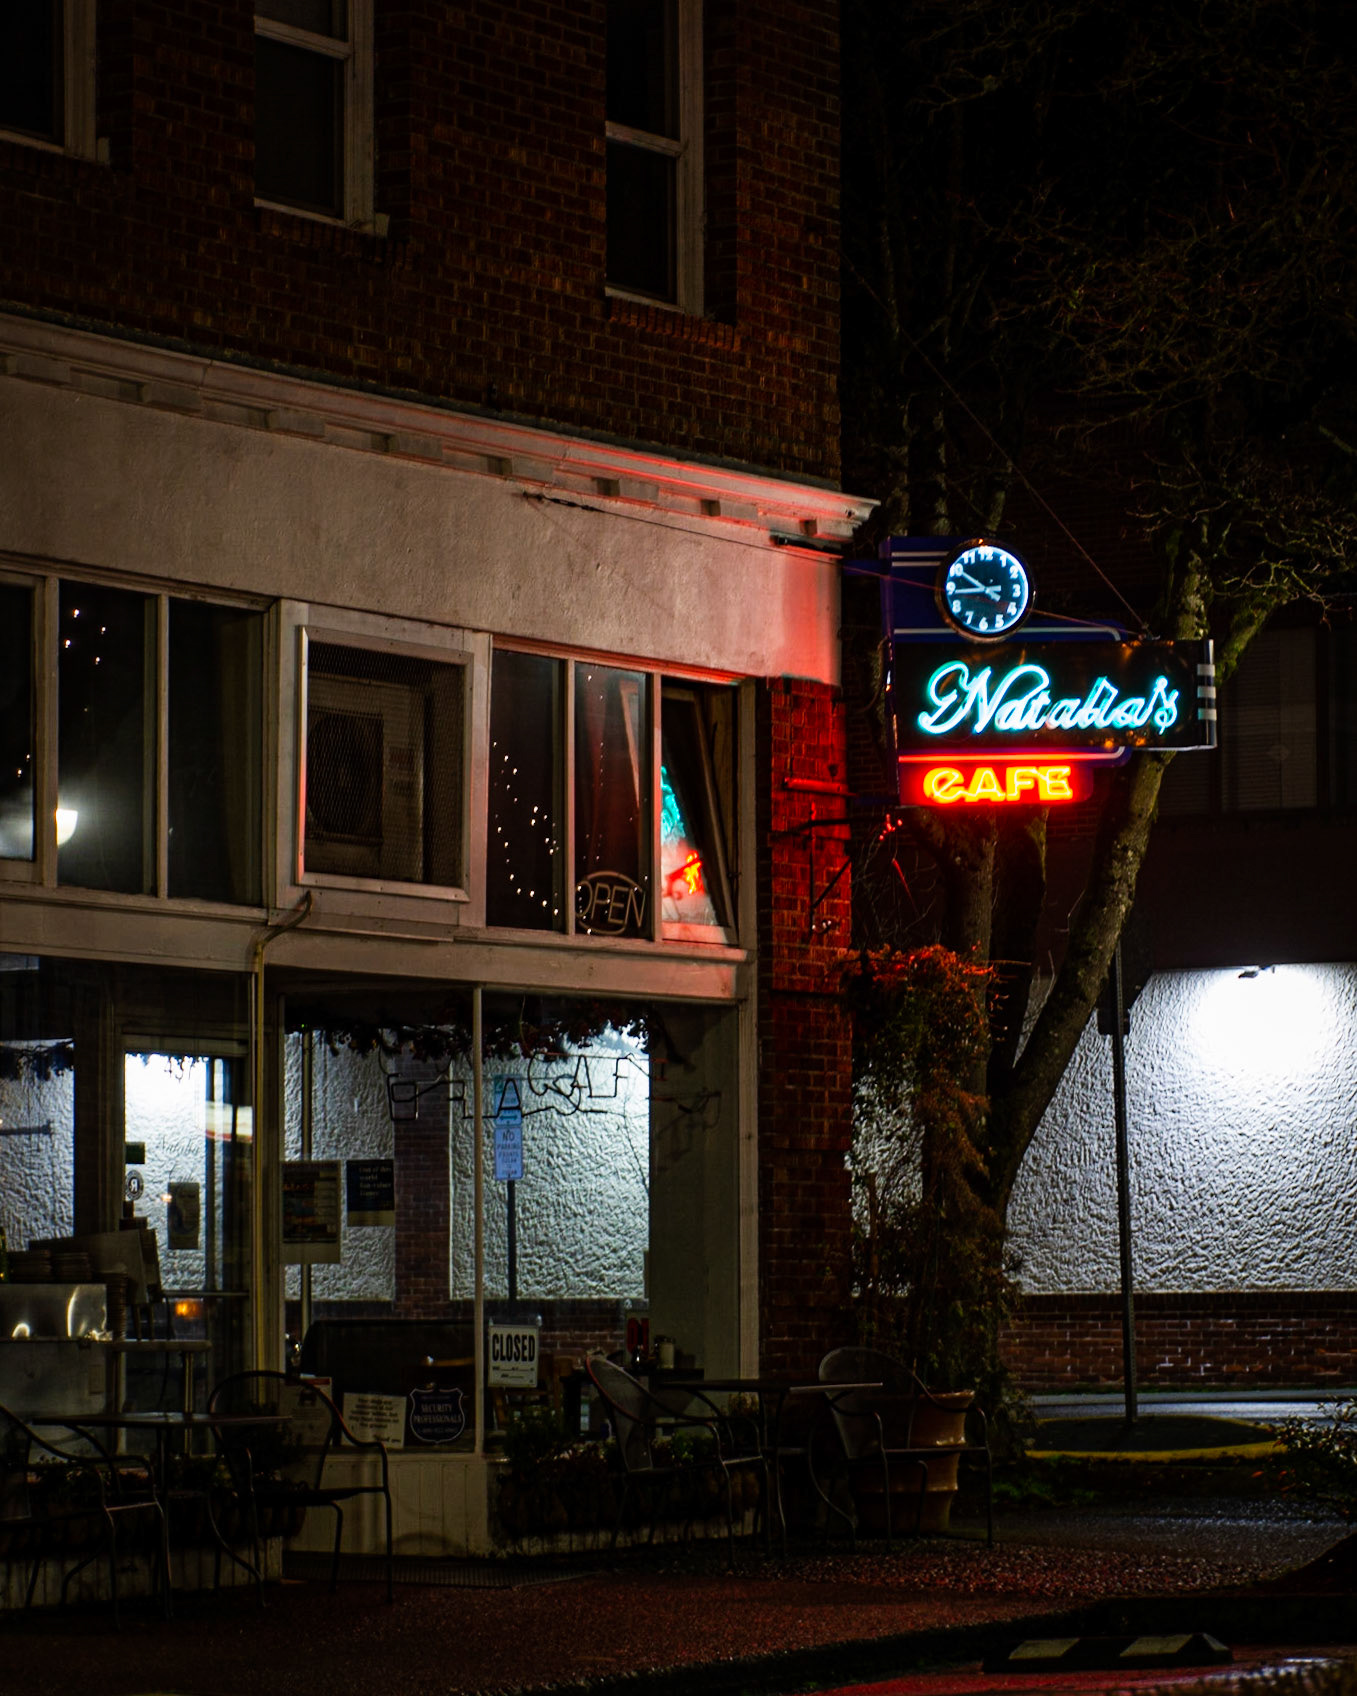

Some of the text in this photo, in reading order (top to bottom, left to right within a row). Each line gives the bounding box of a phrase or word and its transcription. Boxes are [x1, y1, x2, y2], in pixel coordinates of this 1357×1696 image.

[962, 551, 976, 564] 11
[978, 547, 993, 560] 12
[1000, 555, 1007, 567] 1
[950, 563, 963, 577] 10
[1009, 565, 1019, 579] 2
[946, 582, 956, 595] 9
[1012, 584, 1021, 598] 3
[952, 600, 961, 613] 8
[1007, 602, 1017, 616] 4
[965, 611, 974, 624] 7
[979, 617, 988, 631] 6
[995, 614, 1004, 628] 5
[917, 661, 1180, 735] Natalia's
[923, 766, 1074, 803] CAFE
[576, 880, 646, 928] OPEN
[502, 1131, 515, 1141] NO
[492, 1333, 536, 1362] CLOSED
[421, 1403, 453, 1413] SECURITY
